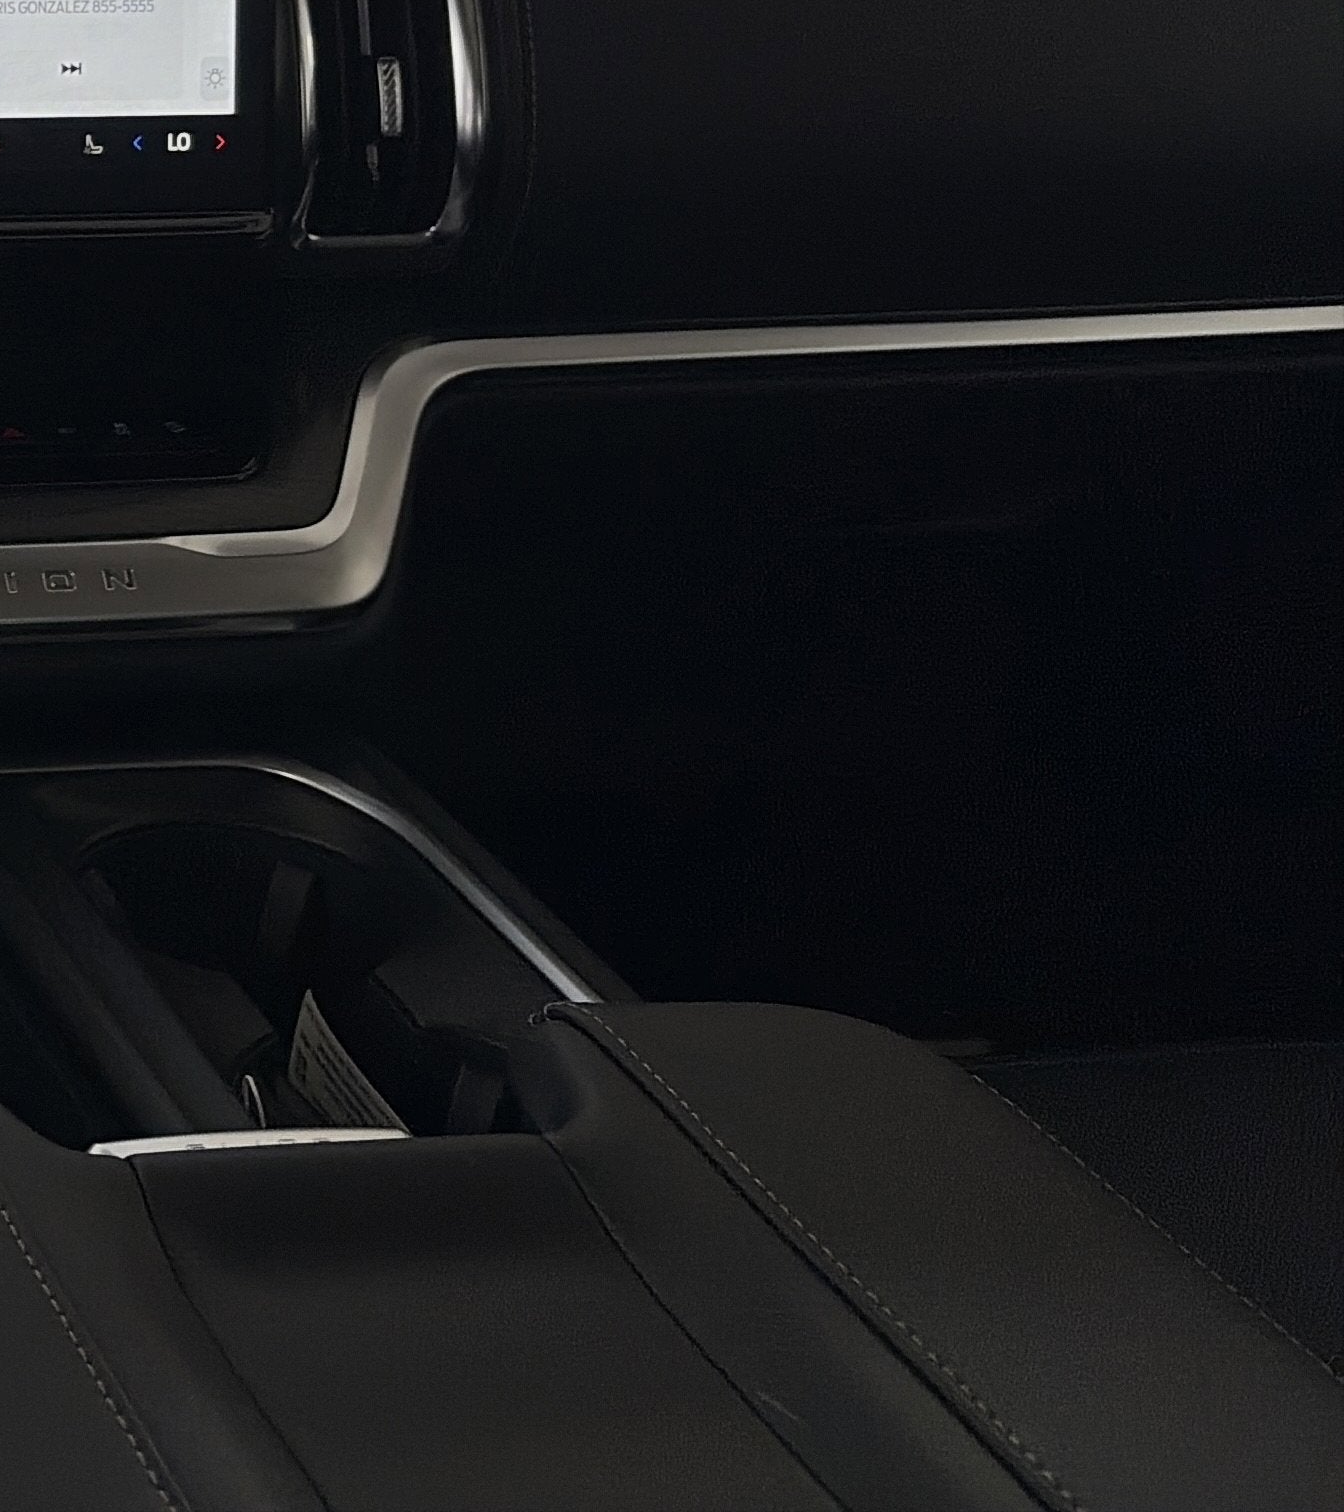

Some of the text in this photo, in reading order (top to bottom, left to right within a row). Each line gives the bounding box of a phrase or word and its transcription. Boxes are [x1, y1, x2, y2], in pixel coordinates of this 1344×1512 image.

[18, 0, 90, 14] GONZALEZ
[92, 0, 155, 13] 855-5555
[167, 132, 191, 151] LO
